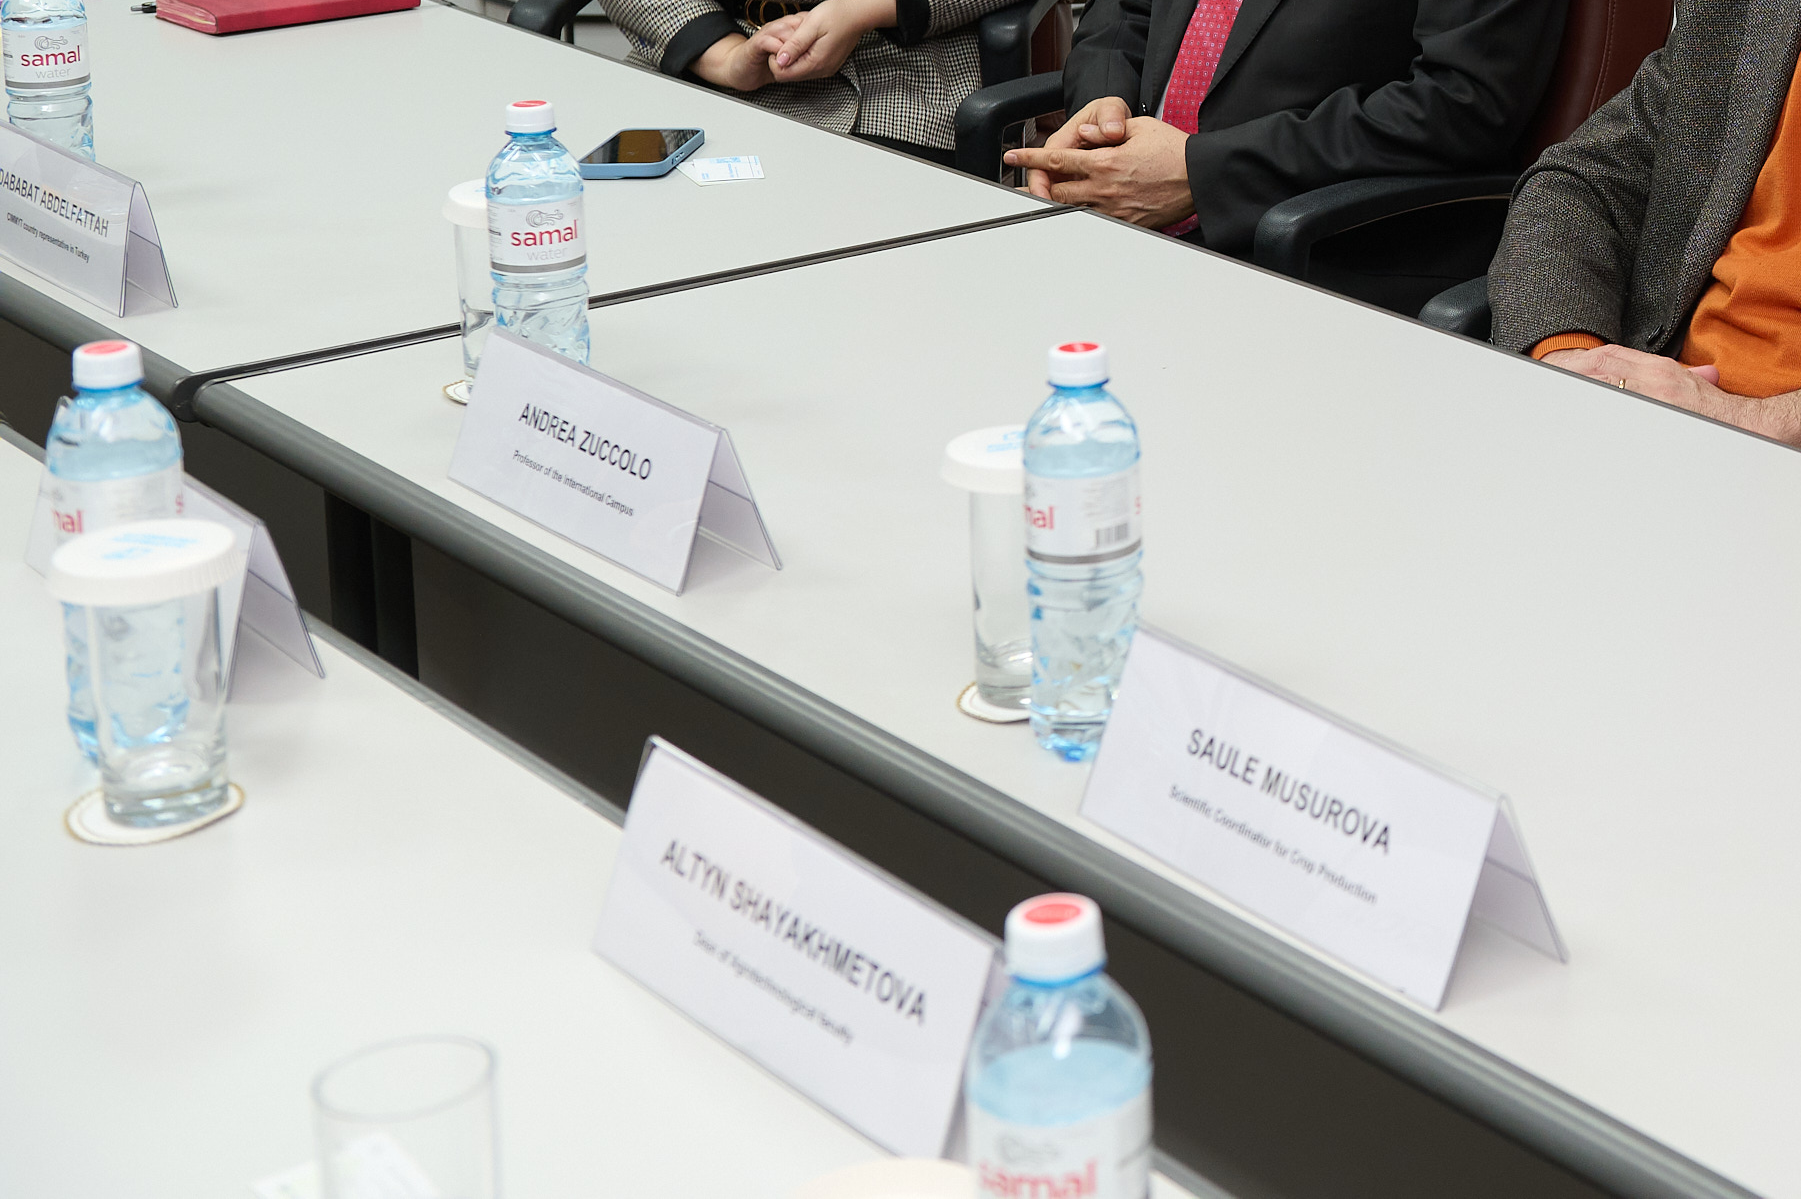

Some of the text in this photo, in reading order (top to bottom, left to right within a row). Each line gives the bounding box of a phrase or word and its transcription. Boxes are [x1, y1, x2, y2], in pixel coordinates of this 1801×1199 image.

[20, 45, 81, 67] samal
[35, 67, 71, 79] water
[0, 168, 109, 237] DABABAT ABDELFATTAH
[510, 219, 578, 247] samal
[527, 248, 568, 261] water
[518, 403, 652, 480] ANDREA ZUCCOLO
[513, 450, 543, 472] Professor
[544, 467, 552, 476] of
[552, 469, 563, 482] the
[605, 495, 634, 516] Campus
[1187, 728, 1390, 855] SAULE MUSUROVA
[1213, 808, 1272, 849] Coordinator
[1317, 863, 1377, 903] Production
[660, 840, 925, 1026] ALTYN SHAYAKHMETOVA
